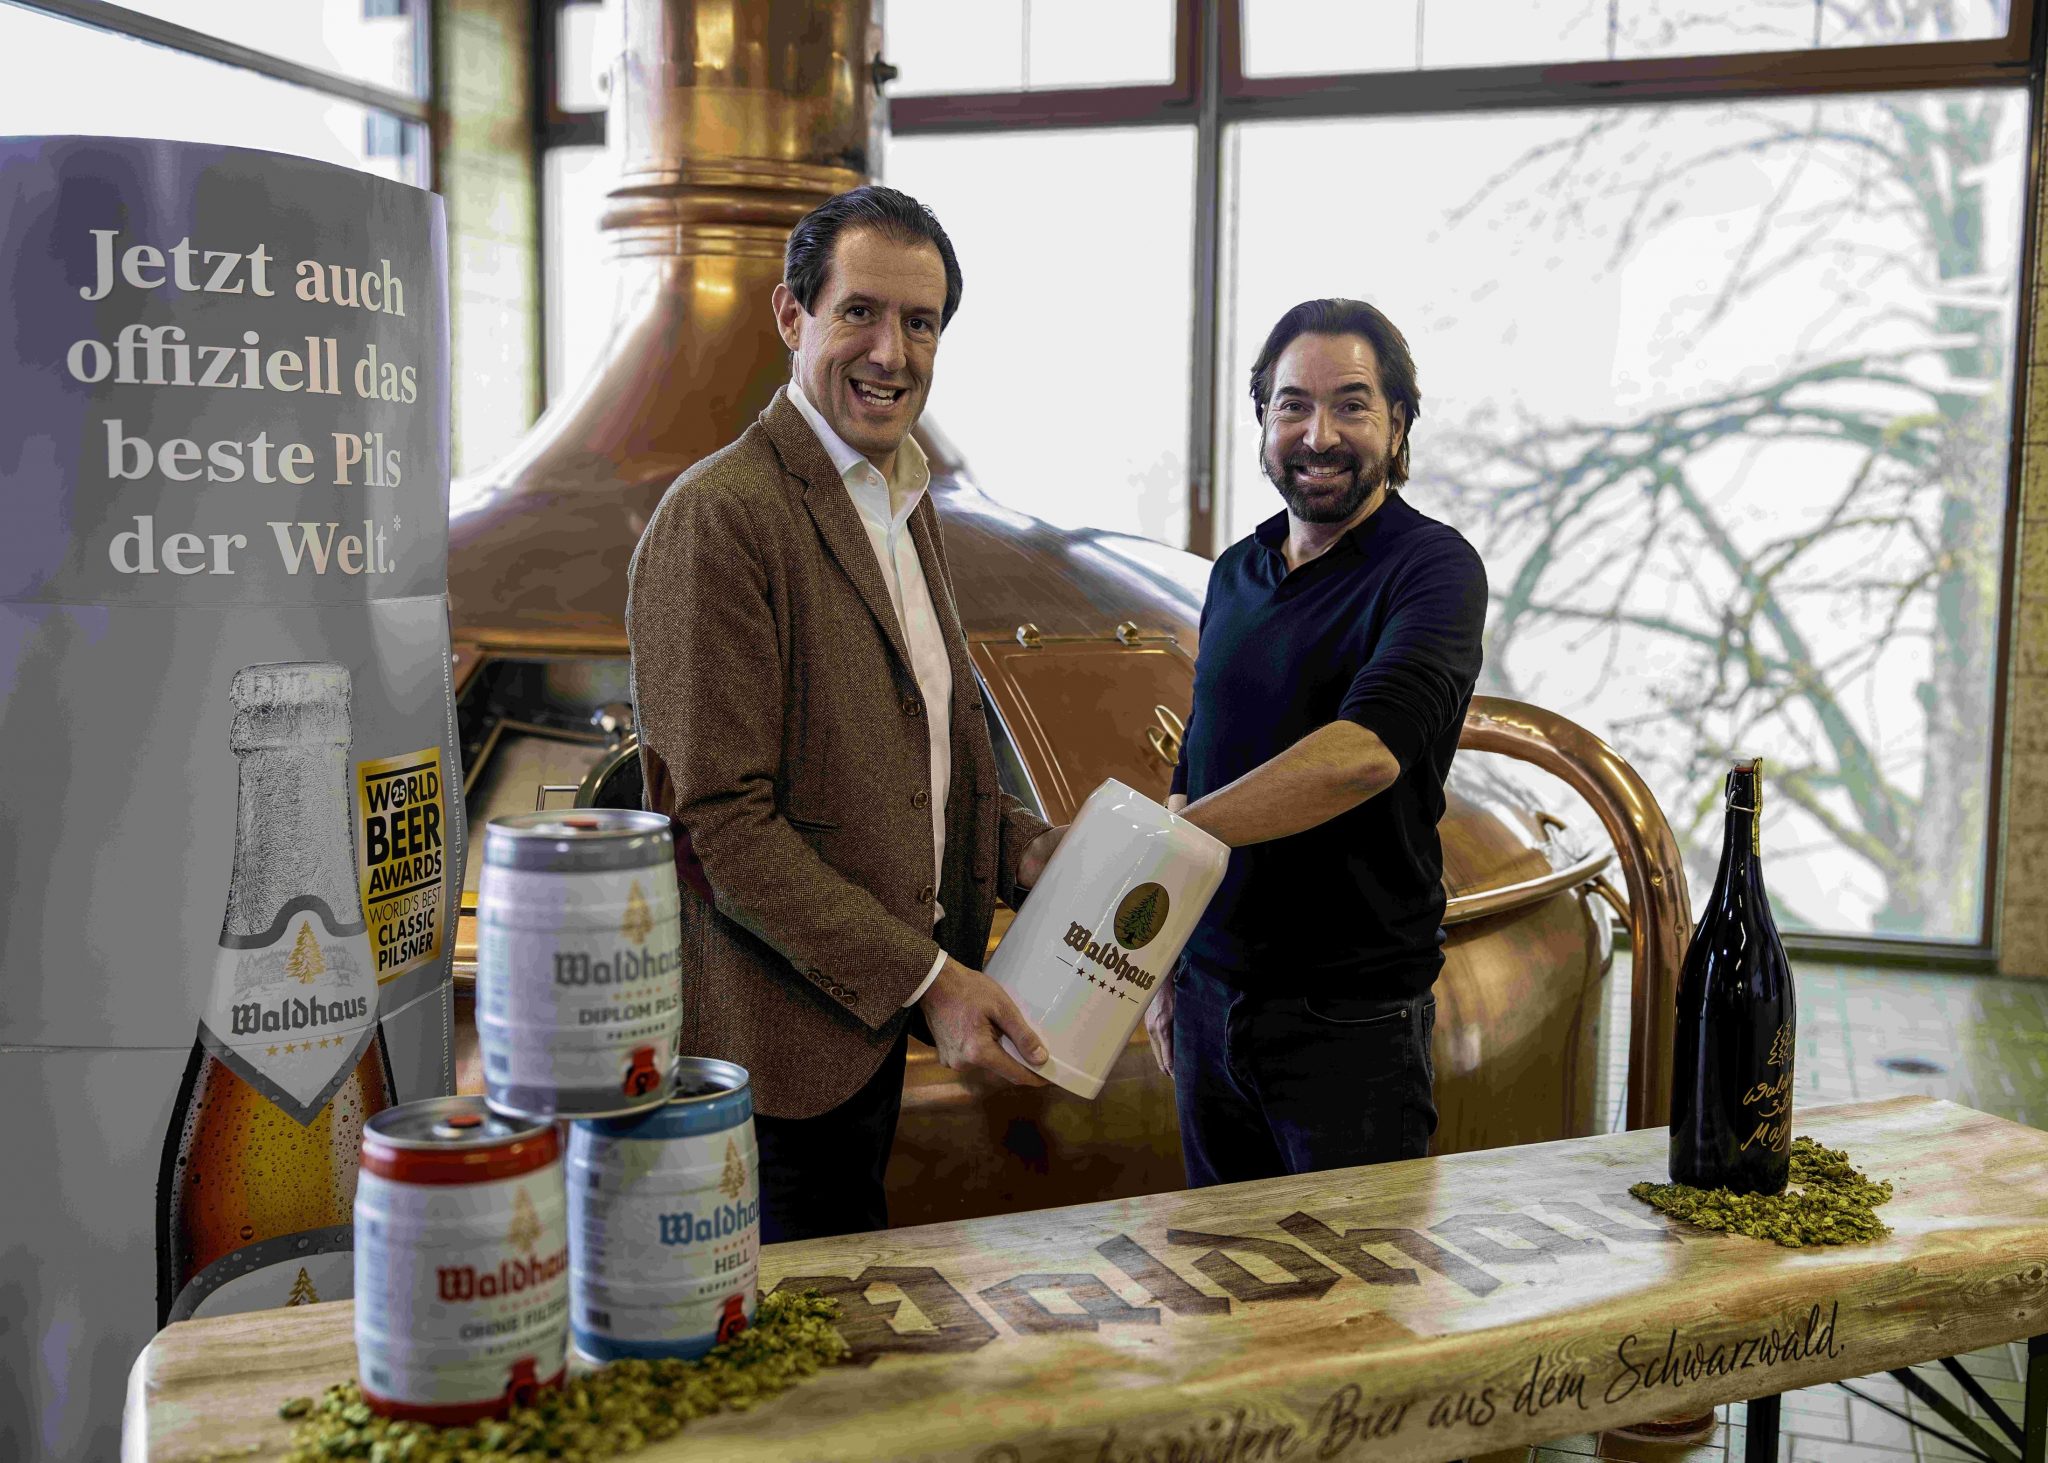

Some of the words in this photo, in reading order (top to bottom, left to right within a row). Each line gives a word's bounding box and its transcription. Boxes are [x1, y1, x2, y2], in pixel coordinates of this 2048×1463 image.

[79, 228, 275, 301] Jetzt
[295, 258, 406, 317] auch
[66, 323, 342, 395] offiziell
[354, 344, 418, 404] das
[102, 419, 316, 485] beste
[331, 431, 402, 488] Pils
[108, 515, 248, 575] der
[366, 802, 442, 867] BEER
[368, 850, 442, 895] AWARDS
[422, 886, 442, 907] BEST
[378, 908, 435, 947] CLASSIC
[378, 932, 434, 972] PILSNER
[1062, 920, 1157, 991] Waldhaus
[231, 995, 368, 1036] Waldhaus
[714, 1247, 750, 1275] HELL
[1312, 1382, 1416, 1461] Bier
[1426, 1386, 1496, 1429] aus
[1512, 1354, 1590, 1417] dem
[1604, 1300, 1845, 1404] Schwarzwald.
